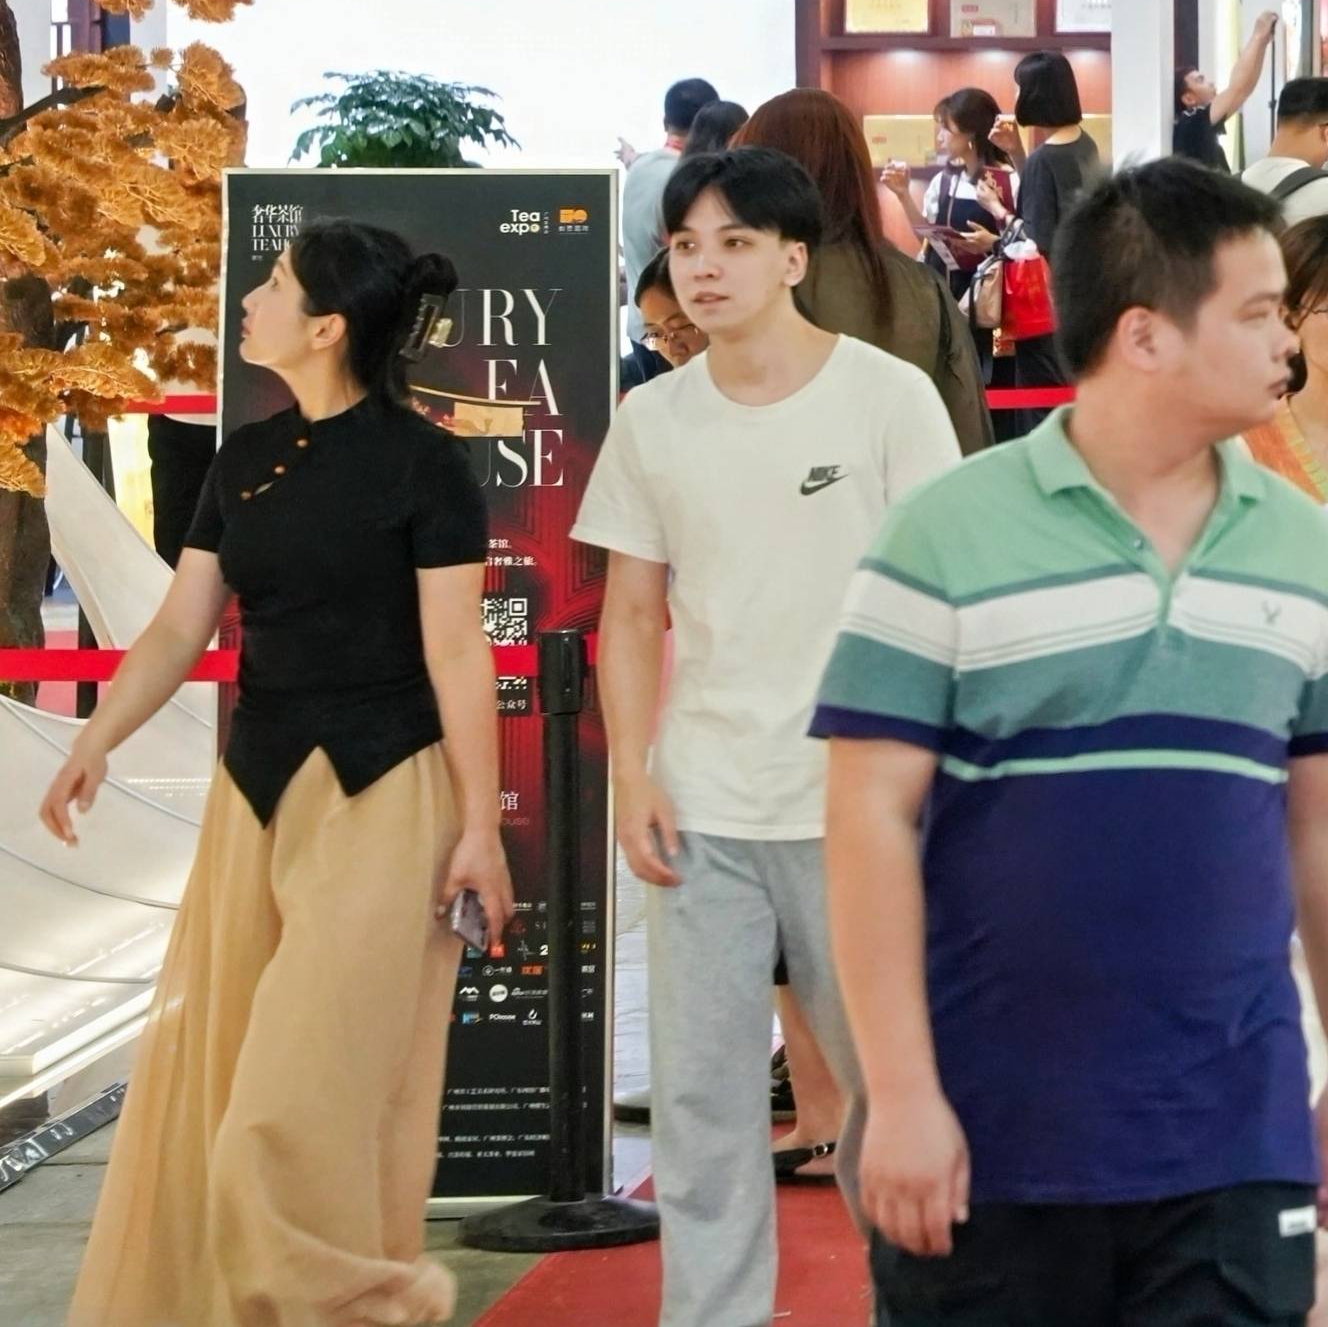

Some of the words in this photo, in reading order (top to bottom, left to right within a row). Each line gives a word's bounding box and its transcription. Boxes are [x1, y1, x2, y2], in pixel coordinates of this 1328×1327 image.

[510, 209, 541, 223] Tea
[499, 222, 541, 236] expo
[482, 429, 564, 488] SE
[807, 464, 842, 482] NIKE
[496, 699, 528, 711] 公众号
[499, 790, 519, 812] 馆
